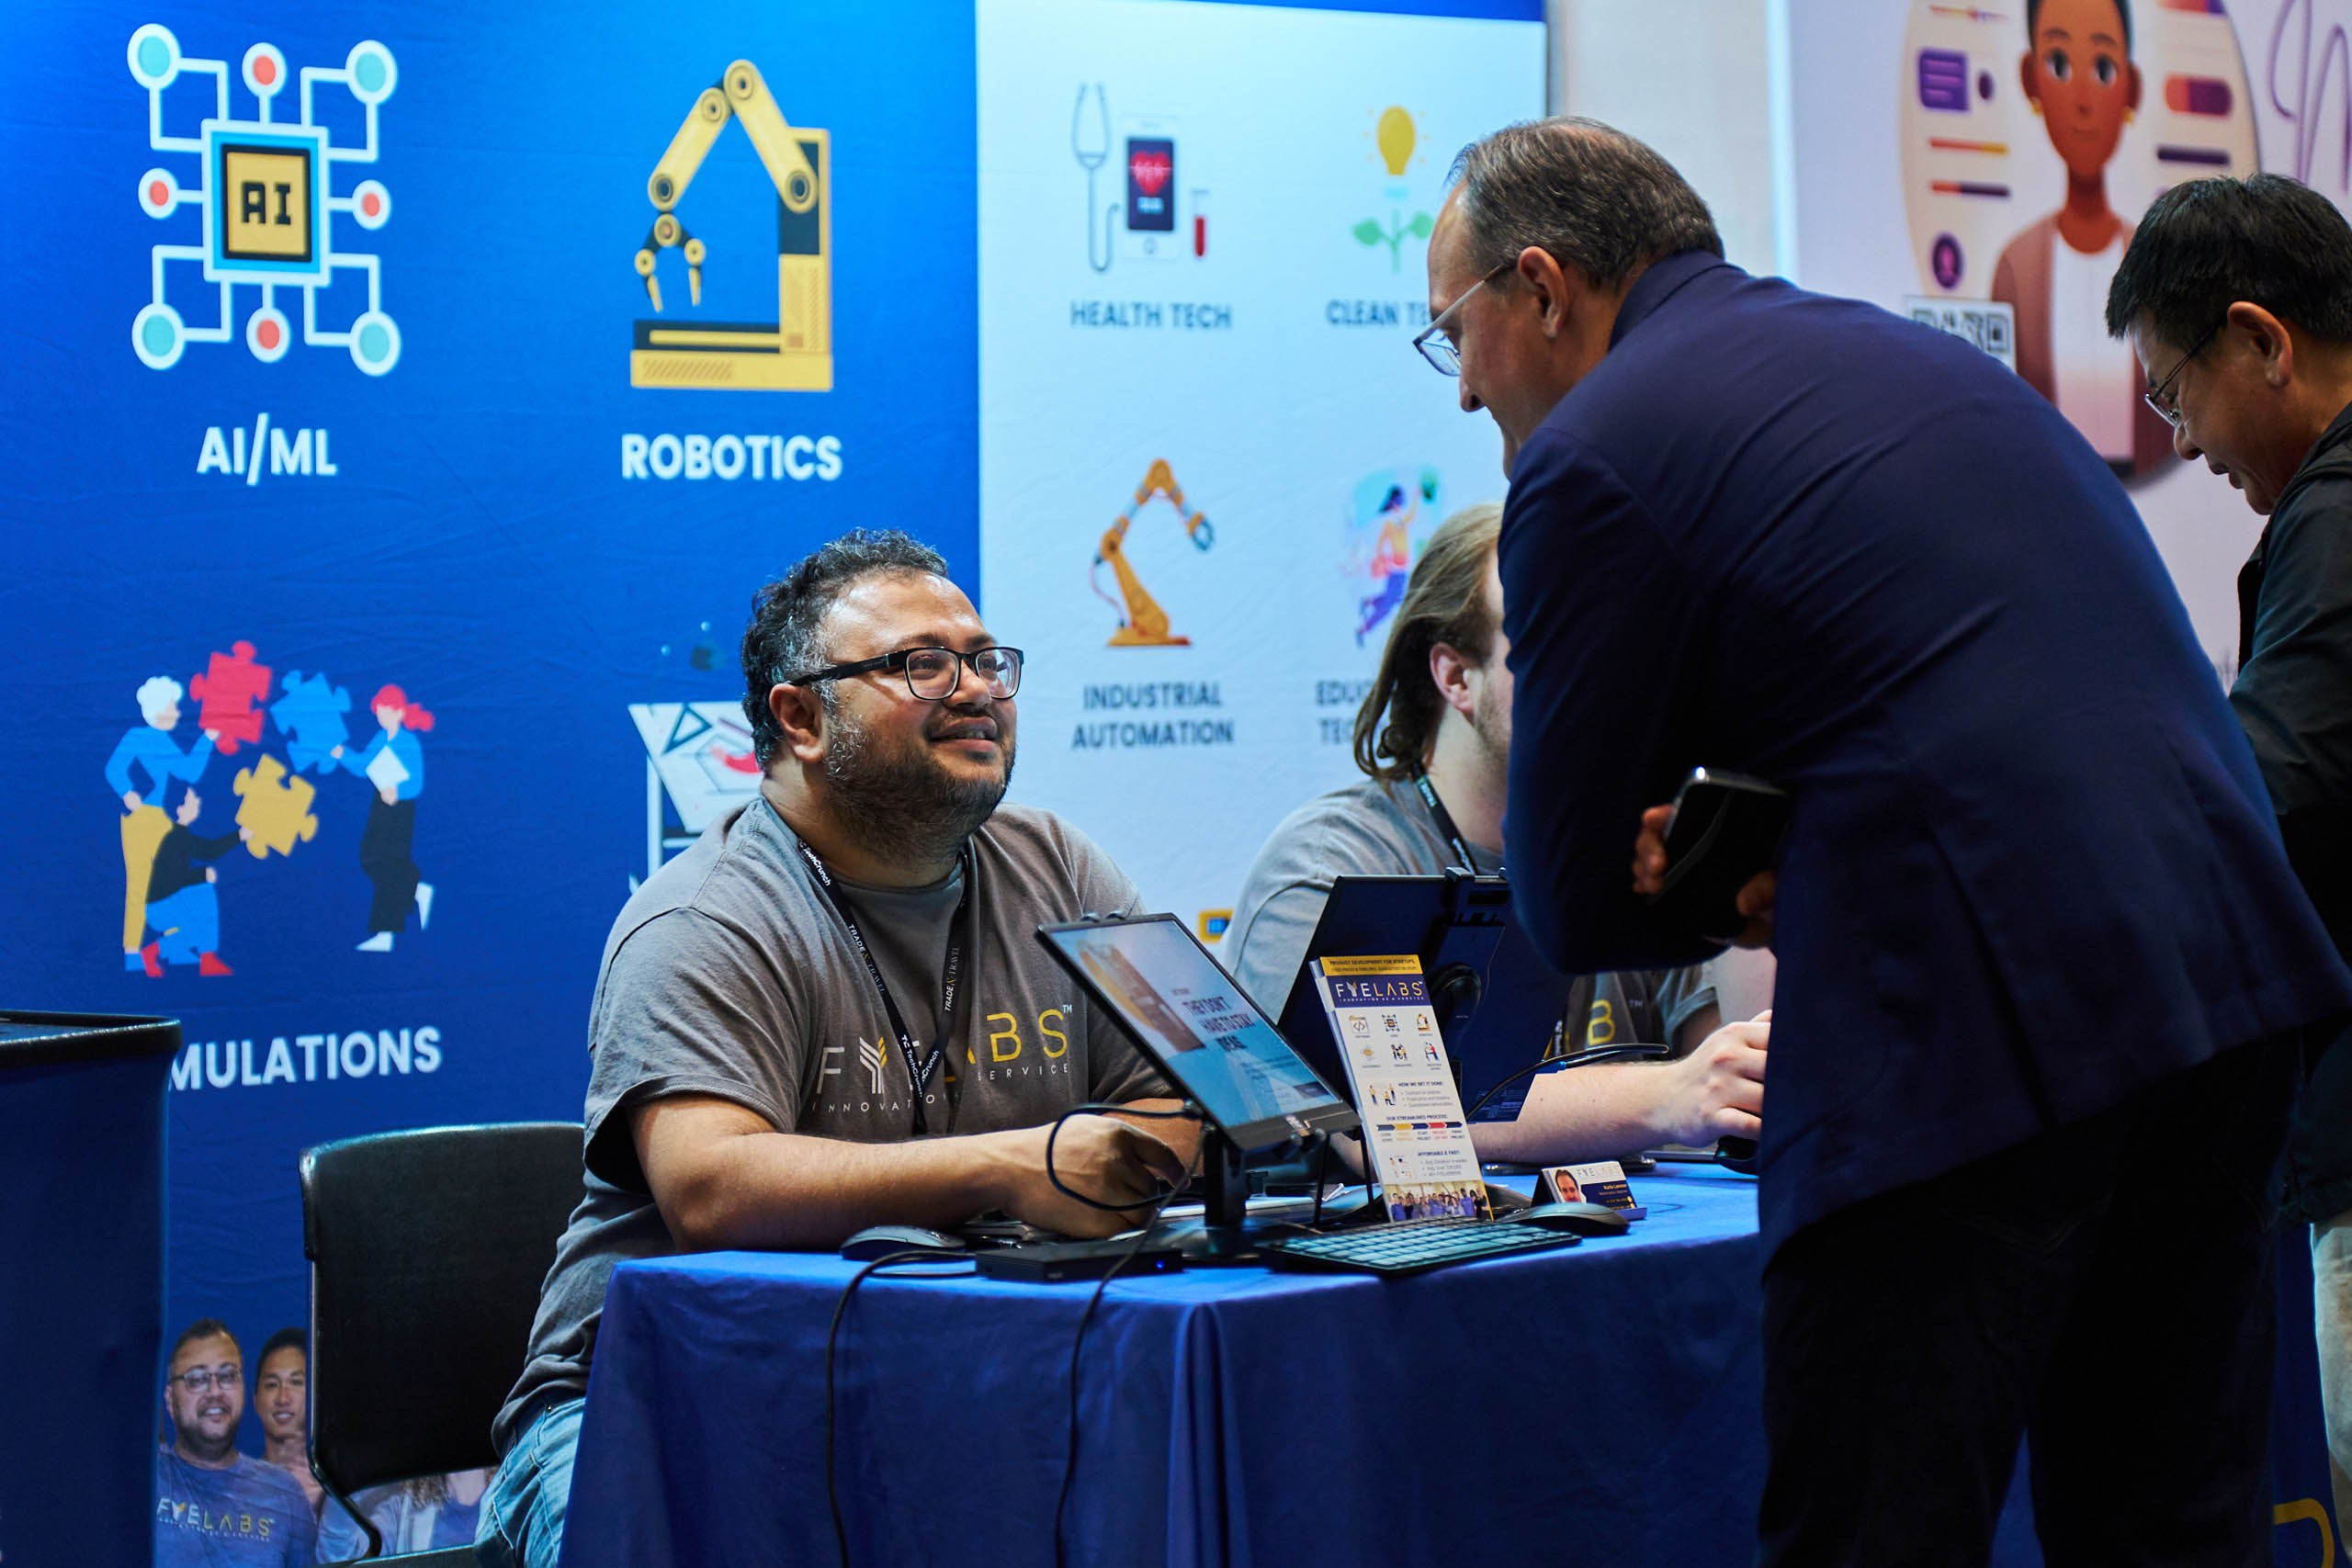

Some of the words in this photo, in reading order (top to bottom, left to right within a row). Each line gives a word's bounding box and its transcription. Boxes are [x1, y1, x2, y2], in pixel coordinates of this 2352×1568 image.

[241, 181, 291, 225] AI
[1070, 299, 1161, 328] HEALTH
[1171, 302, 1233, 330] TECH
[1325, 299, 1398, 325] CLEAN
[1407, 301, 1430, 325] TE
[196, 412, 338, 487] AI/ML
[621, 433, 843, 481] ROBOTICS
[1082, 682, 1223, 710] INDUSTRIAL
[1315, 680, 1374, 705] EDU
[1071, 719, 1235, 750] AUTOMATION
[802, 846, 831, 887] TechCrunch
[847, 923, 866, 954] TRADE
[944, 984, 955, 1012] TRADE
[1335, 982, 1423, 998] FYELABS
[169, 1026, 442, 1092] MULATIONS
[816, 1009, 1068, 1095] FYBS
[922, 1050, 940, 1082] Crunch
[978, 1063, 1069, 1082] SERVICE
[156, 1496, 271, 1537] FYELABS
